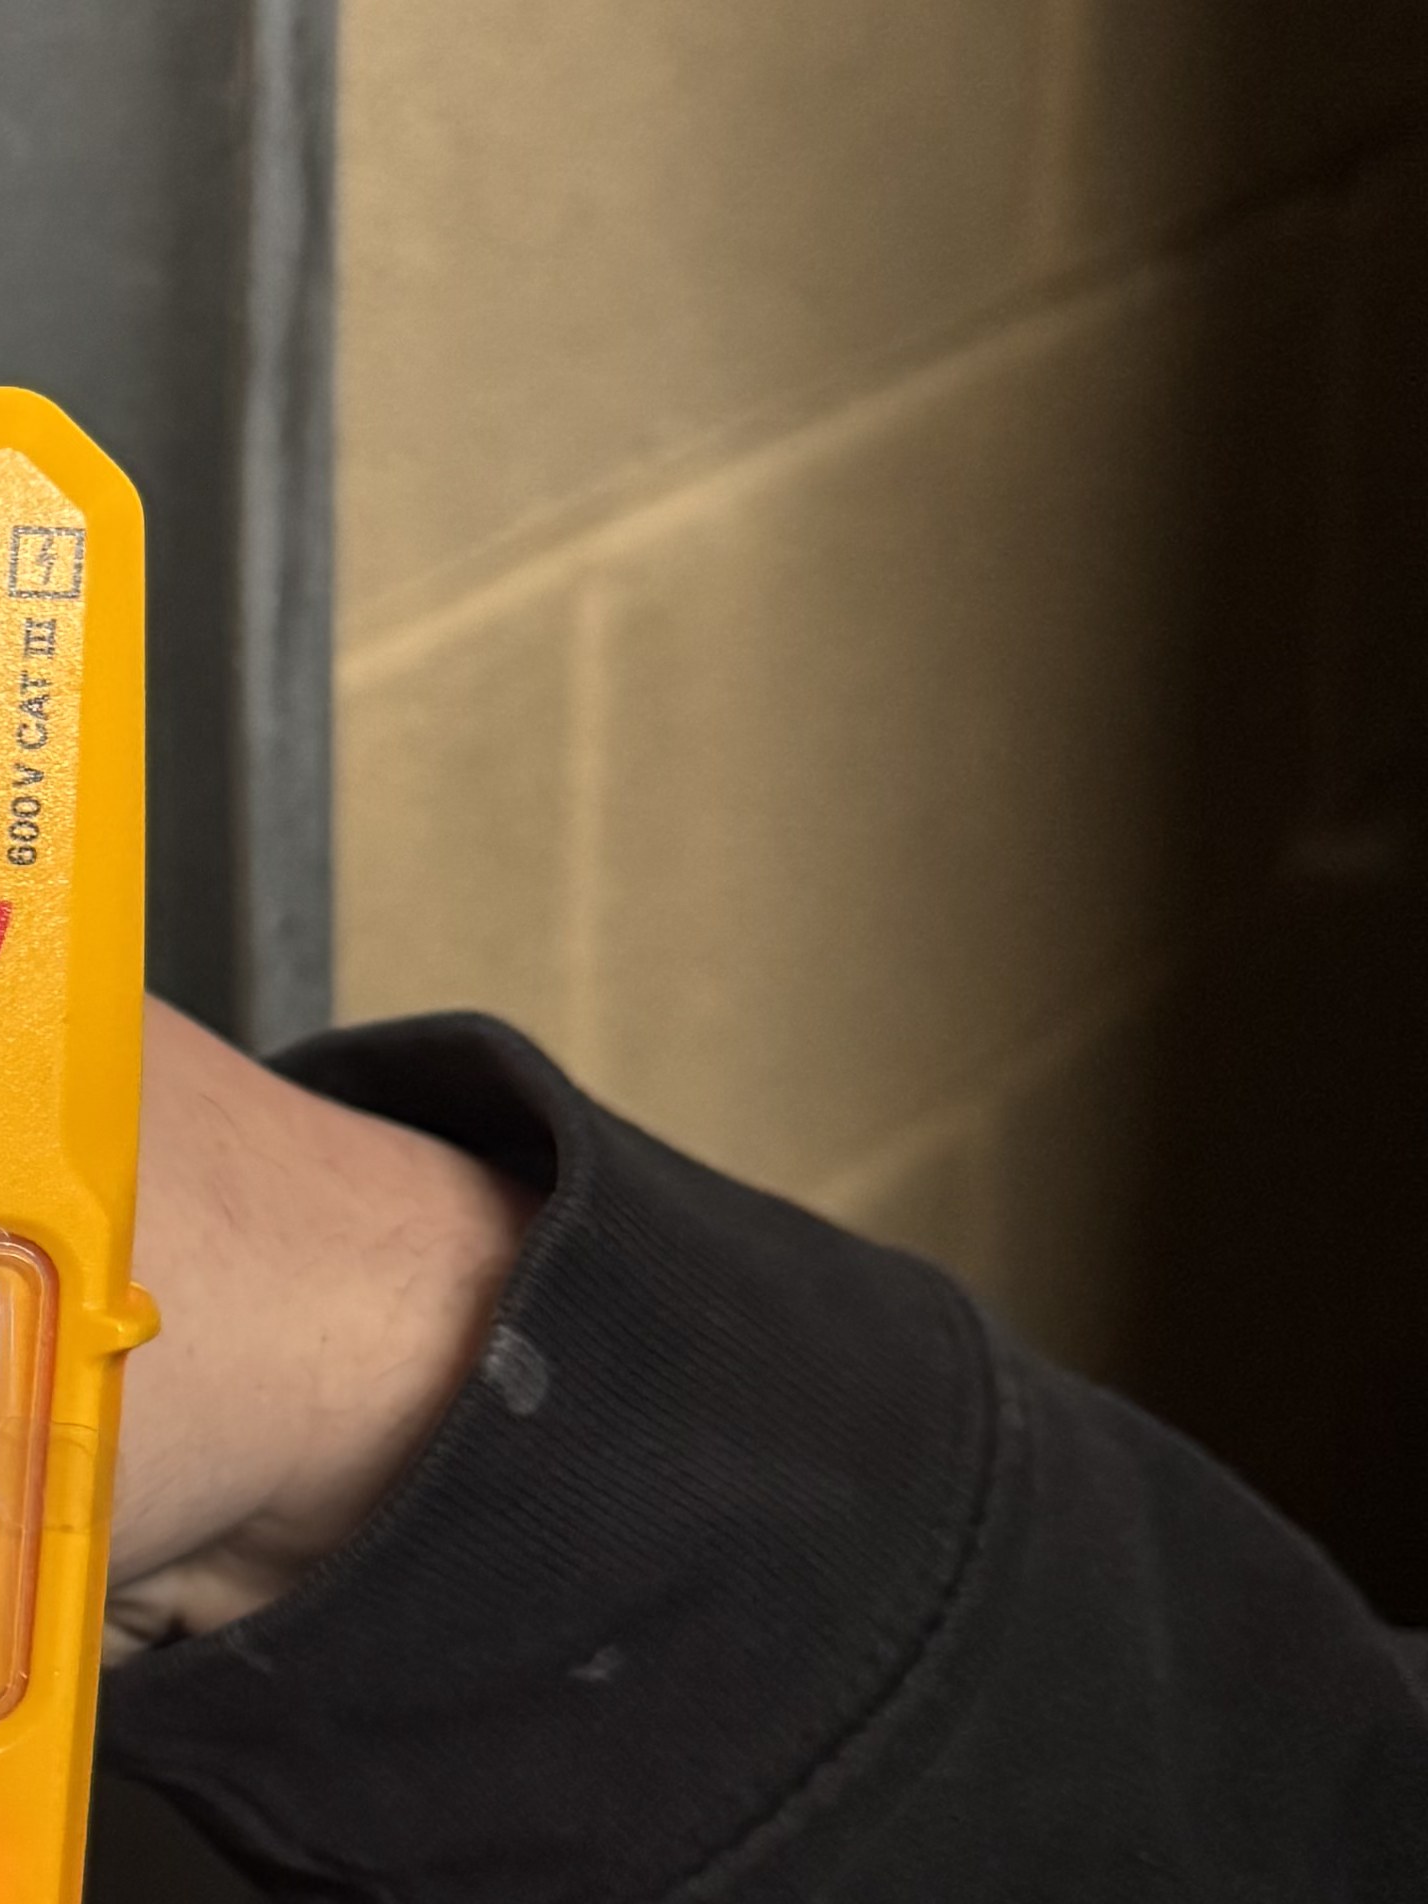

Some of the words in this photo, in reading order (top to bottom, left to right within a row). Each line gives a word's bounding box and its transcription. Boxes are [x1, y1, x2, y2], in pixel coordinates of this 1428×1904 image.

[16, 670, 50, 751] CAT
[12, 763, 44, 791] V
[6, 795, 42, 868] 600
